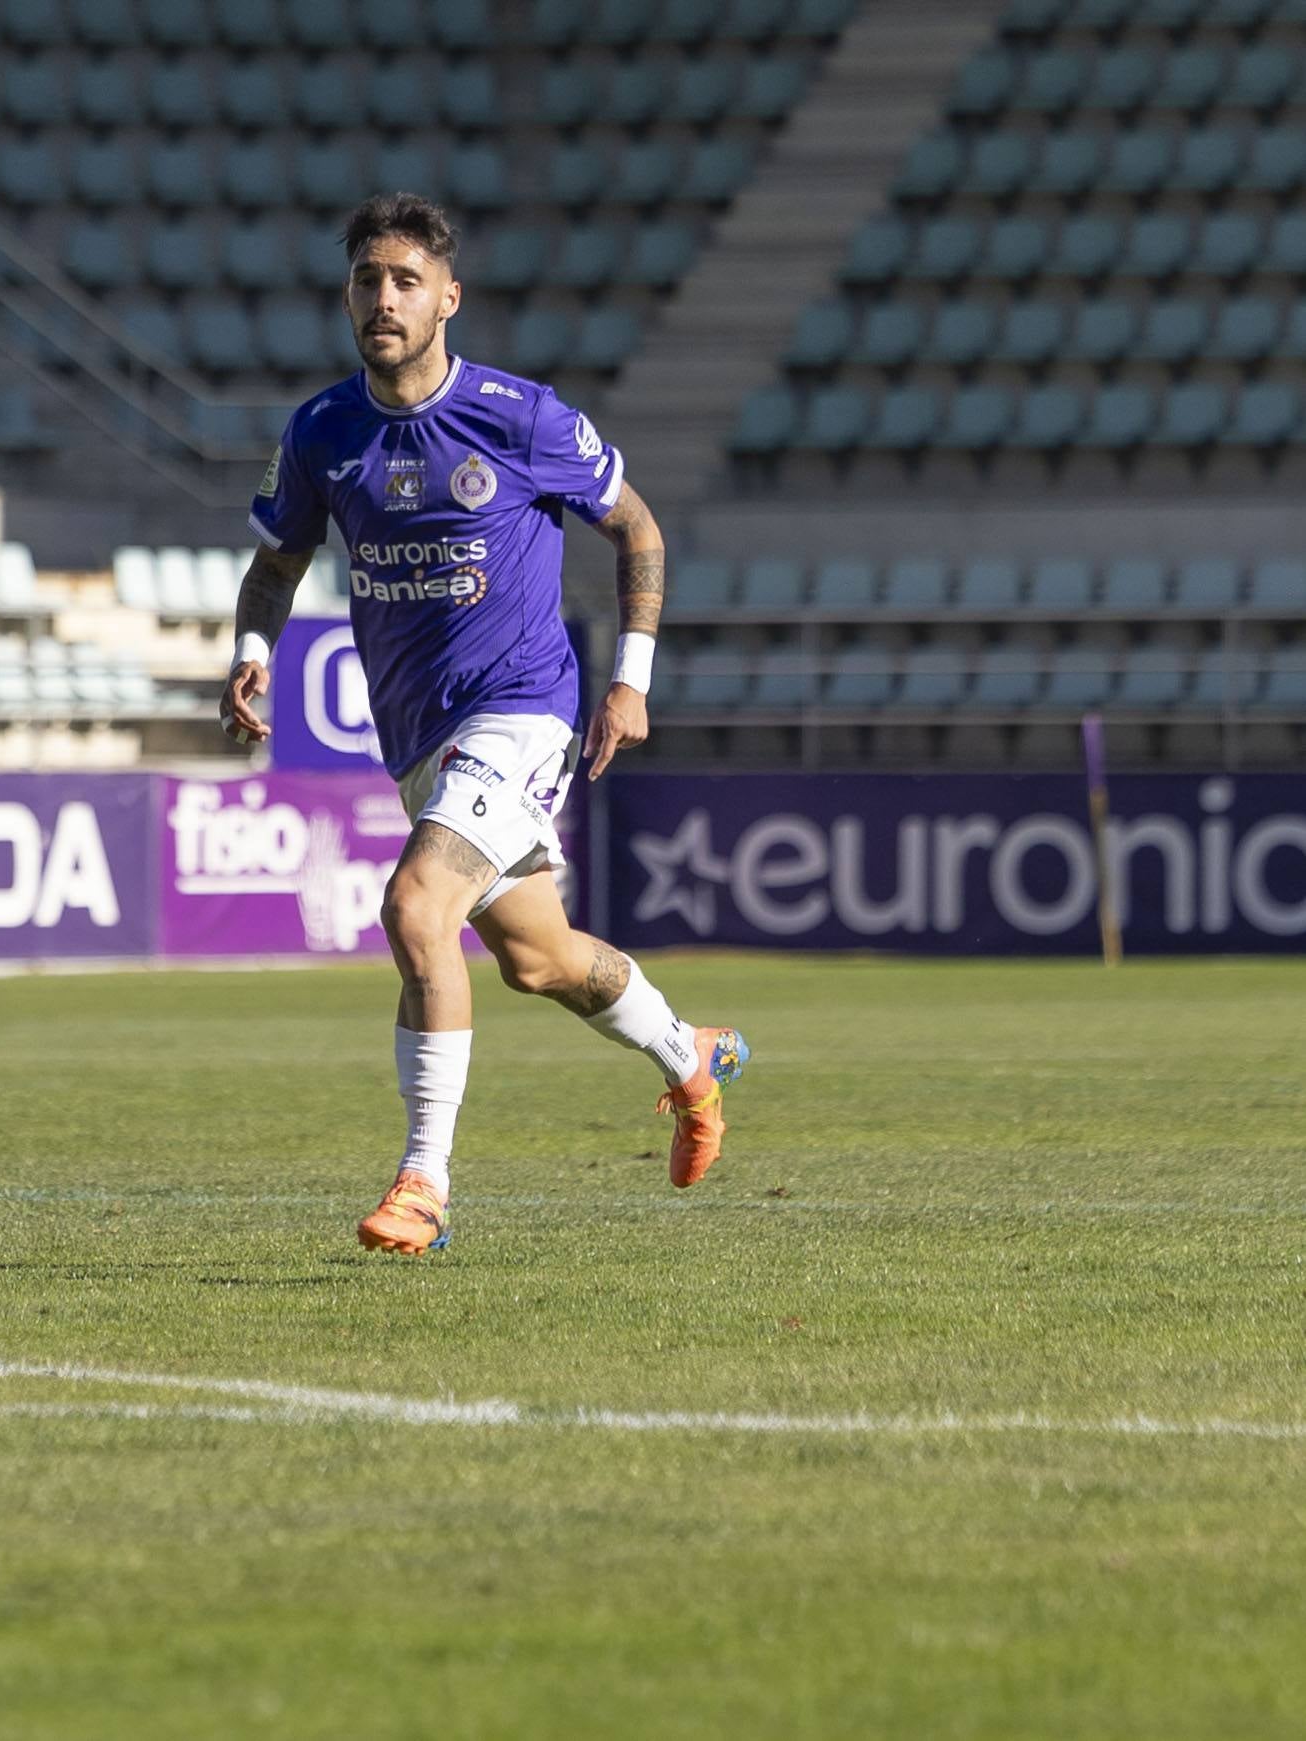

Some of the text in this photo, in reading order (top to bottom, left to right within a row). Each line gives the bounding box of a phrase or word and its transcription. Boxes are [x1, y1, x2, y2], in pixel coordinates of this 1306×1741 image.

[358, 537, 488, 566] euronics
[350, 567, 478, 603] Danisa
[472, 794, 487, 817] 6
[168, 781, 309, 877] fisio
